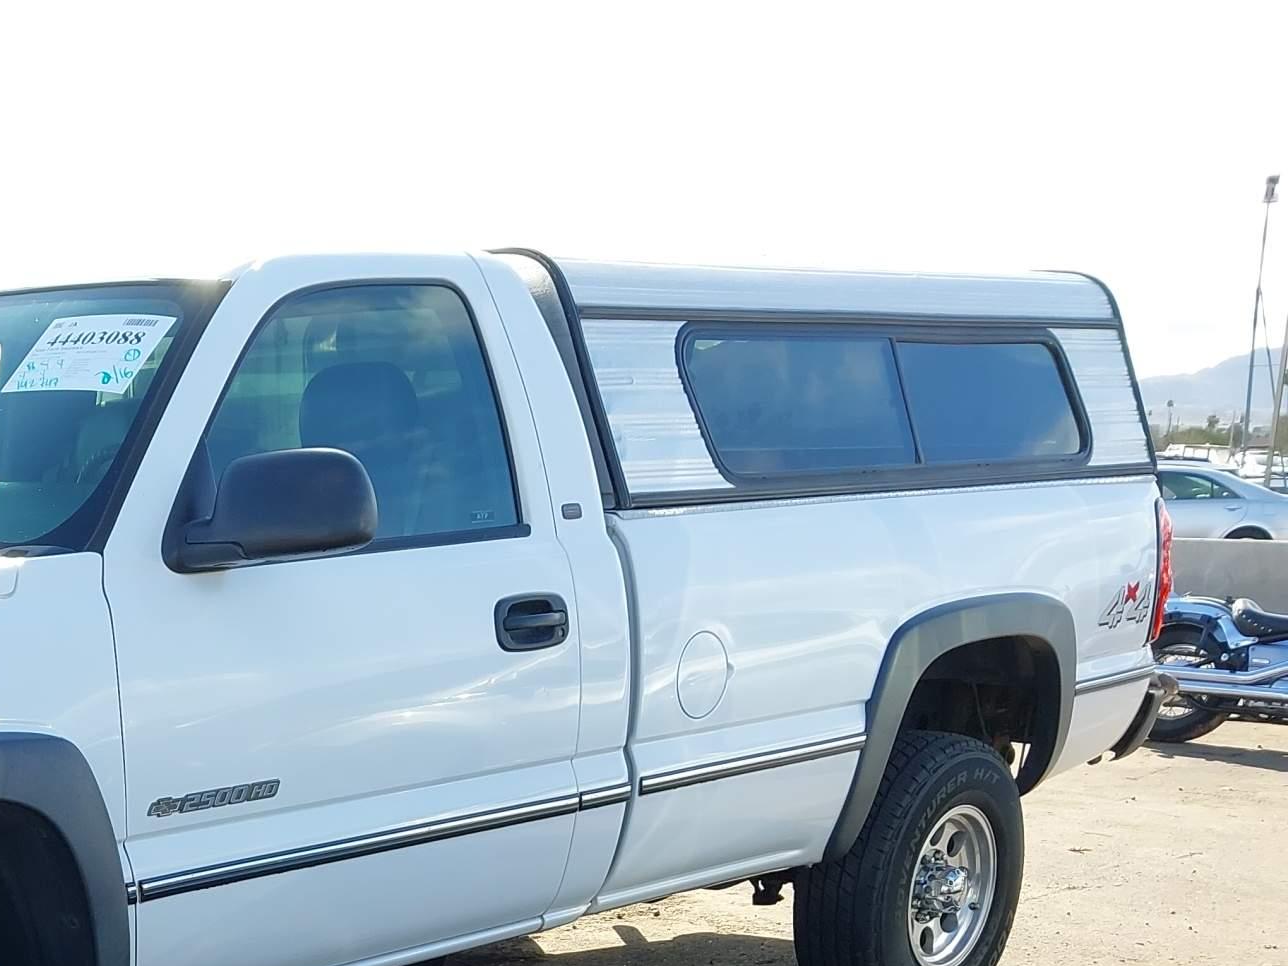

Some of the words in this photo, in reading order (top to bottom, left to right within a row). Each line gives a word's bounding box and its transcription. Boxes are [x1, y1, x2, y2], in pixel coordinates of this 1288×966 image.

[46, 330, 147, 346] 44403088
[182, 785, 250, 813] 2500
[250, 781, 280, 800] HD
